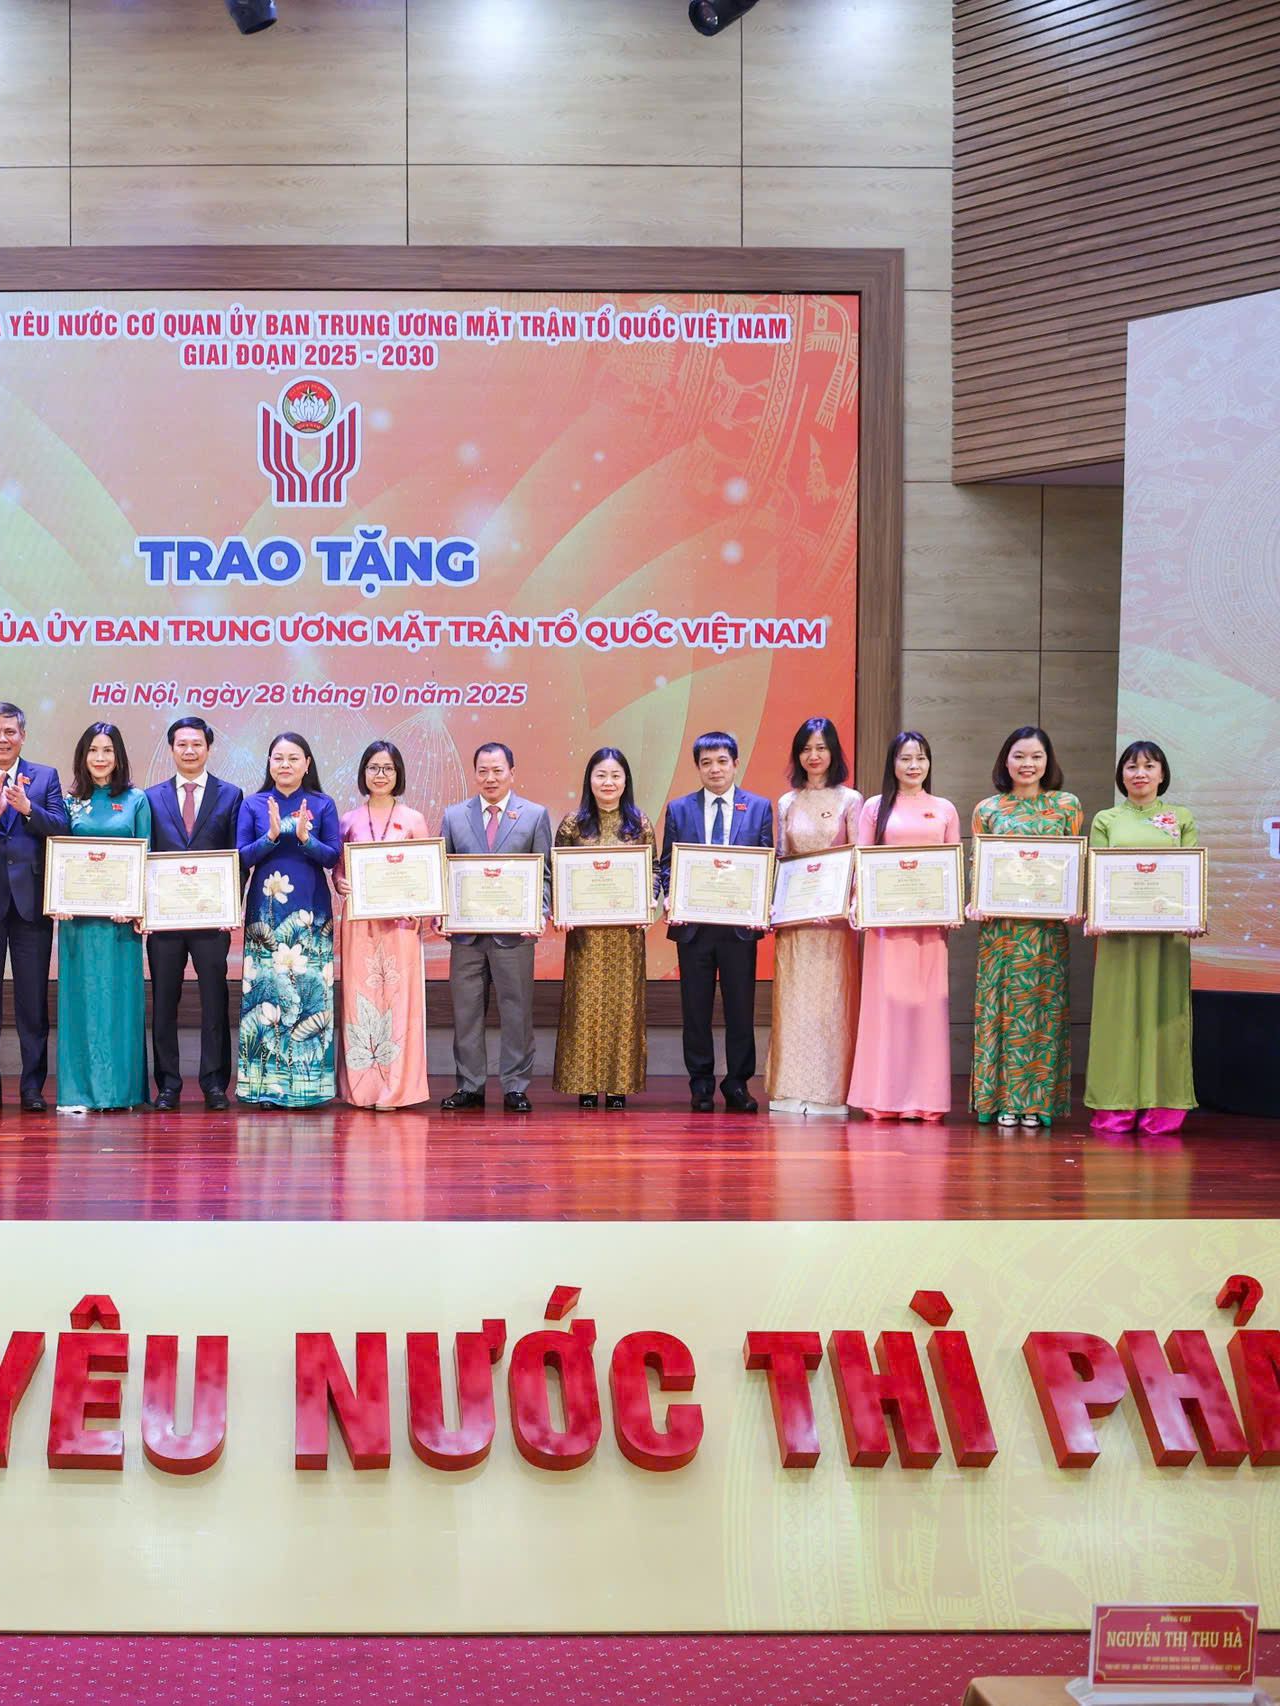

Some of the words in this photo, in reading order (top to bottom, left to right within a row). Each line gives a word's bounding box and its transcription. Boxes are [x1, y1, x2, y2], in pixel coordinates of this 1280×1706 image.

[9, 311, 49, 336] YÊU
[58, 310, 117, 336] NƯỚC
[126, 313, 155, 336] CƠ
[163, 314, 221, 338] QUAN
[230, 307, 257, 336] ỦY
[266, 314, 309, 336] BAN
[318, 314, 390, 336] TRUNG
[398, 313, 457, 336] ƯƠNG
[466, 311, 512, 341] MẶT
[520, 312, 576, 342] TRẬN
[584, 307, 611, 337] TỔ
[619, 308, 676, 340] QUỐC
[684, 313, 730, 343] VIỆT
[737, 318, 787, 339] NAM
[183, 344, 227, 366] GIAI
[236, 344, 296, 370] ĐOẠN
[304, 344, 357, 366] 2025
[381, 344, 434, 366] 2030
[139, 540, 302, 582] TRAO
[316, 530, 475, 594] TẶNG
[47, 612, 88, 643] ỦY
[95, 620, 159, 642] BAN
[168, 620, 270, 642] TRUNG
[279, 616, 368, 642] ƯƠNG
[376, 615, 442, 649] MẶT
[448, 615, 529, 649] TRẬN
[537, 613, 578, 643] TỔ
[585, 614, 673, 647] QUỐC
[681, 616, 747, 650] VIỆT
[755, 622, 822, 644] NAM
[91, 684, 126, 703] Hà
[133, 682, 179, 708] Nội,
[186, 683, 251, 708] ngày
[255, 684, 285, 703] 28
[292, 684, 367, 708] tháng
[373, 685, 398, 703] 10
[403, 684, 461, 704] năm
[466, 685, 526, 704] 2025
[295, 1285, 704, 1471] NƯỚC
[743, 1290, 998, 1469] THÌ
[1165, 1631, 1188, 1652] THỊ
[1192, 1631, 1220, 1648] THU
[1223, 1626, 1243, 1648] HÀ
